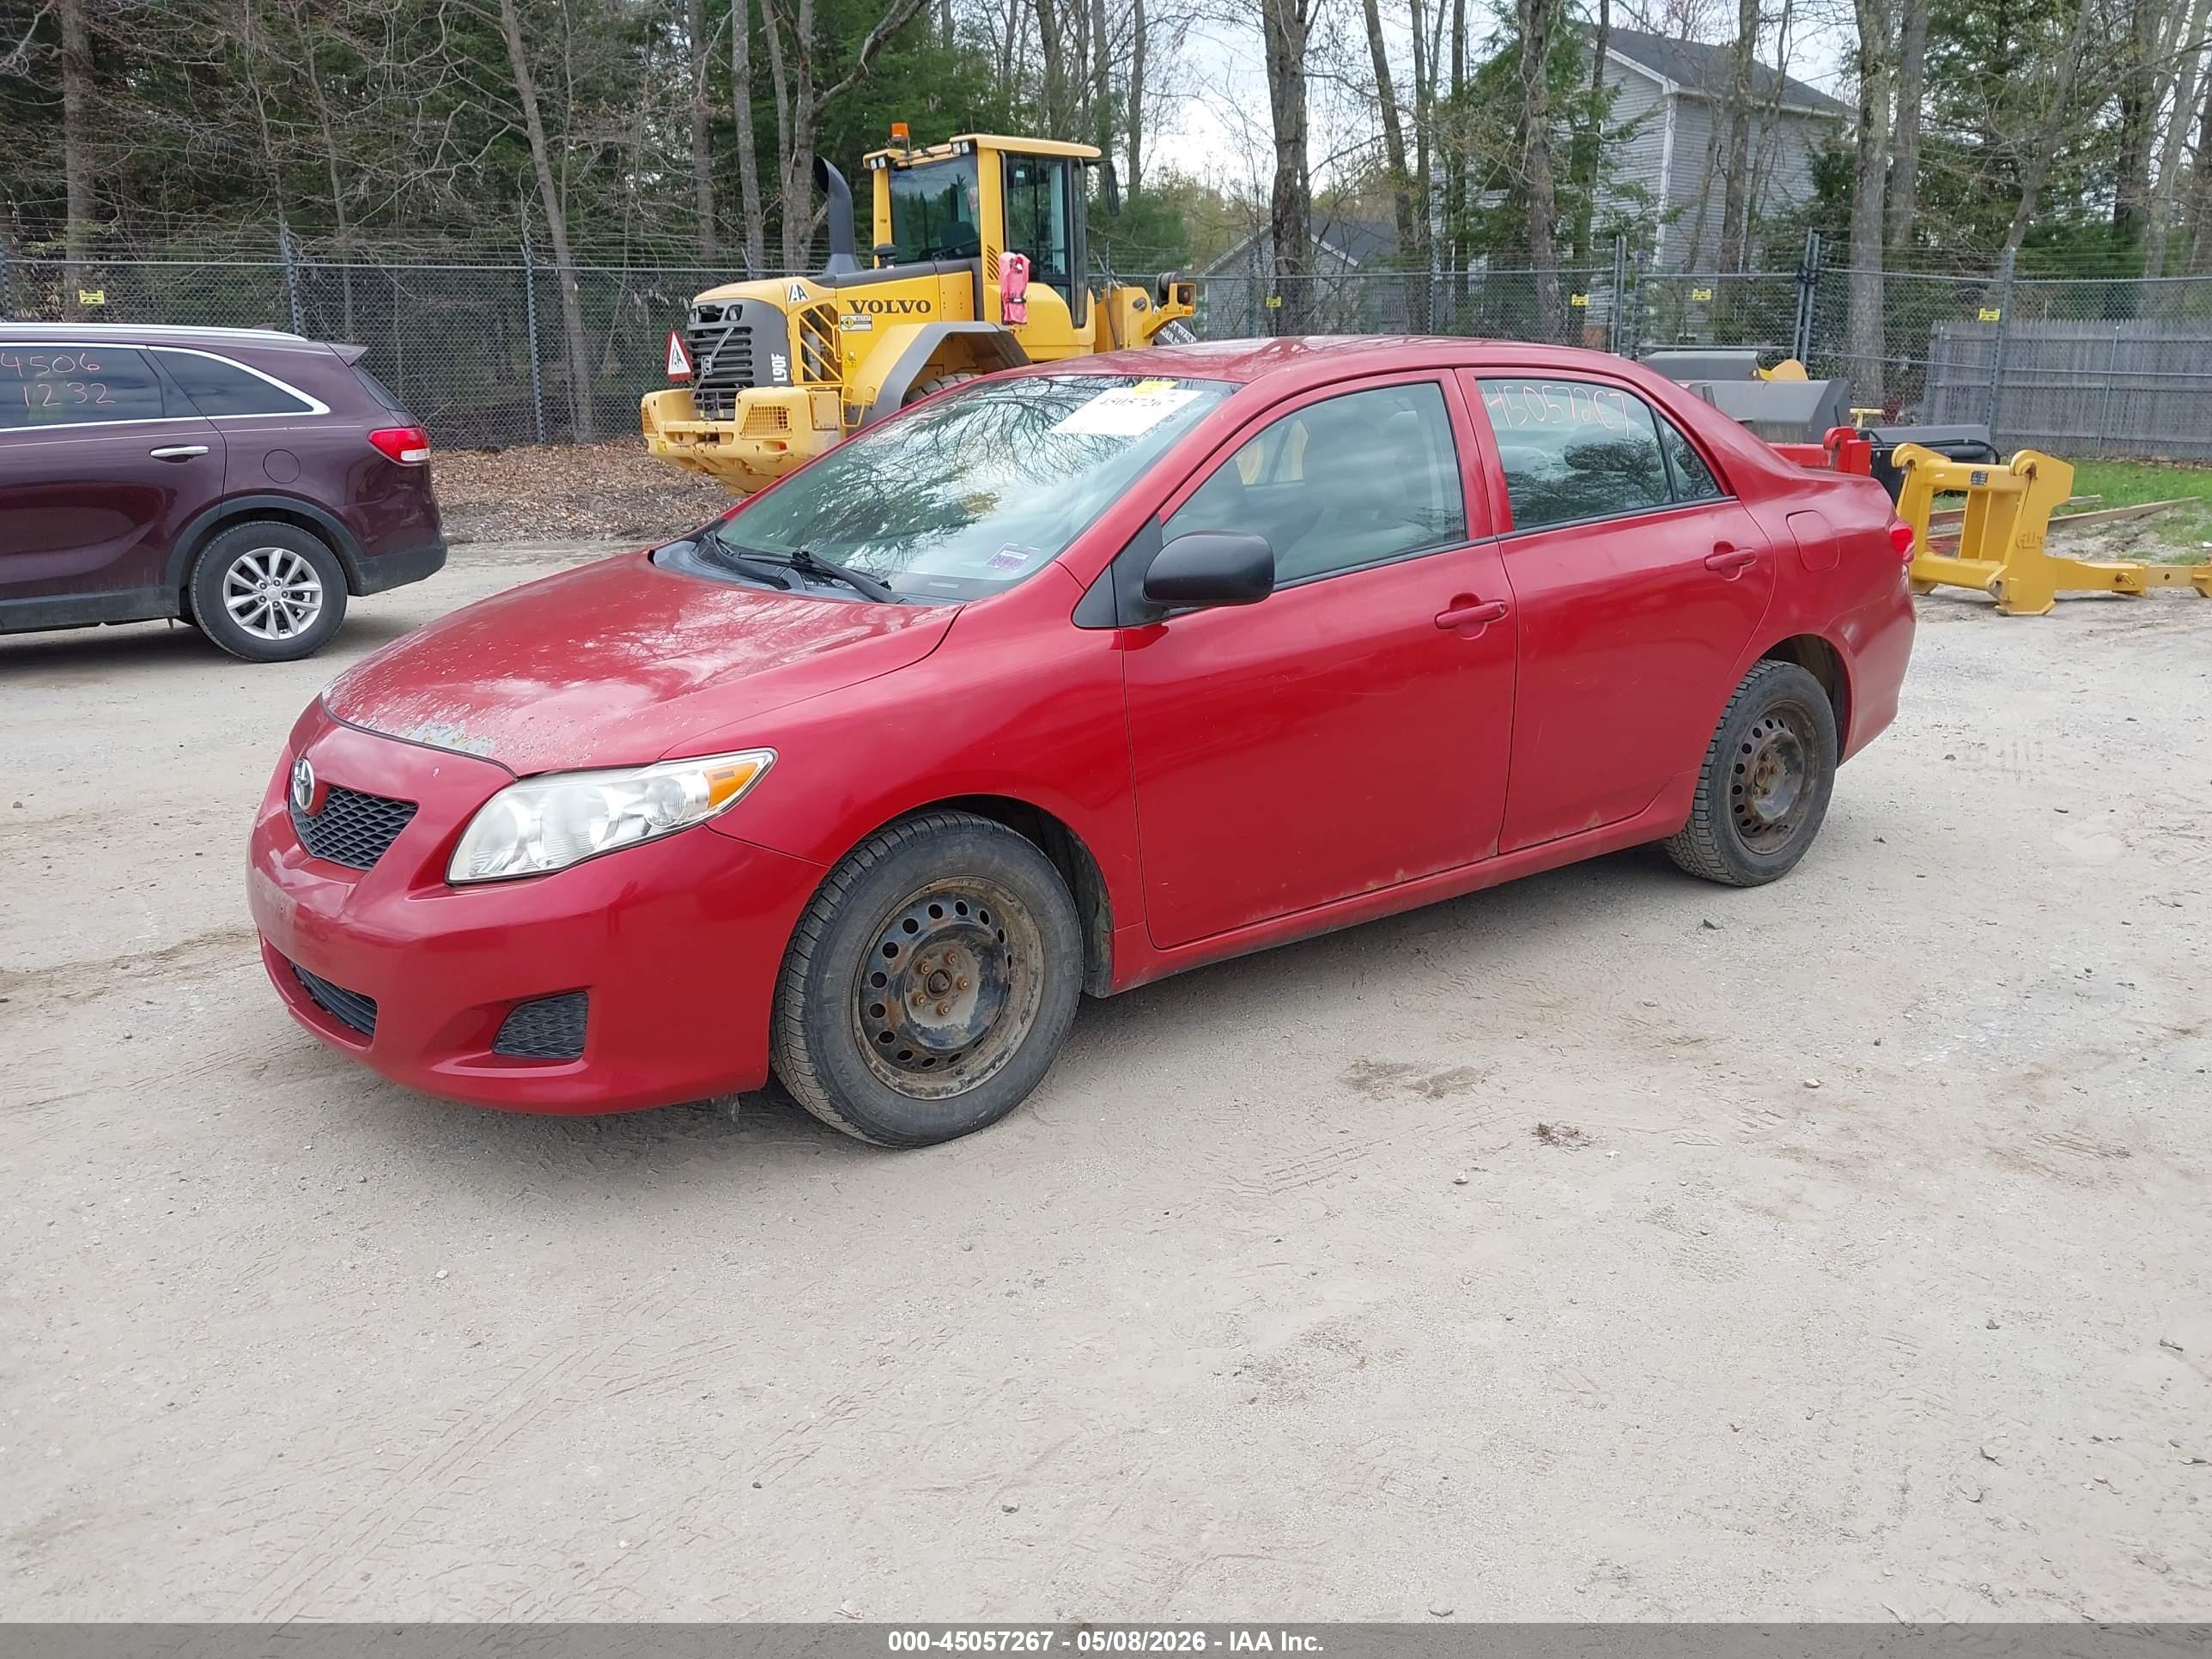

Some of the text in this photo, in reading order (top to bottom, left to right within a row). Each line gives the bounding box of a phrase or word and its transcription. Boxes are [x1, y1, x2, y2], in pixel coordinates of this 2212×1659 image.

[847, 300, 931, 313] VOLVO
[1, 352, 100, 378] 4506
[771, 353, 787, 383] L90F
[23, 382, 116, 407] 1232
[1482, 386, 1630, 439] 45057267
